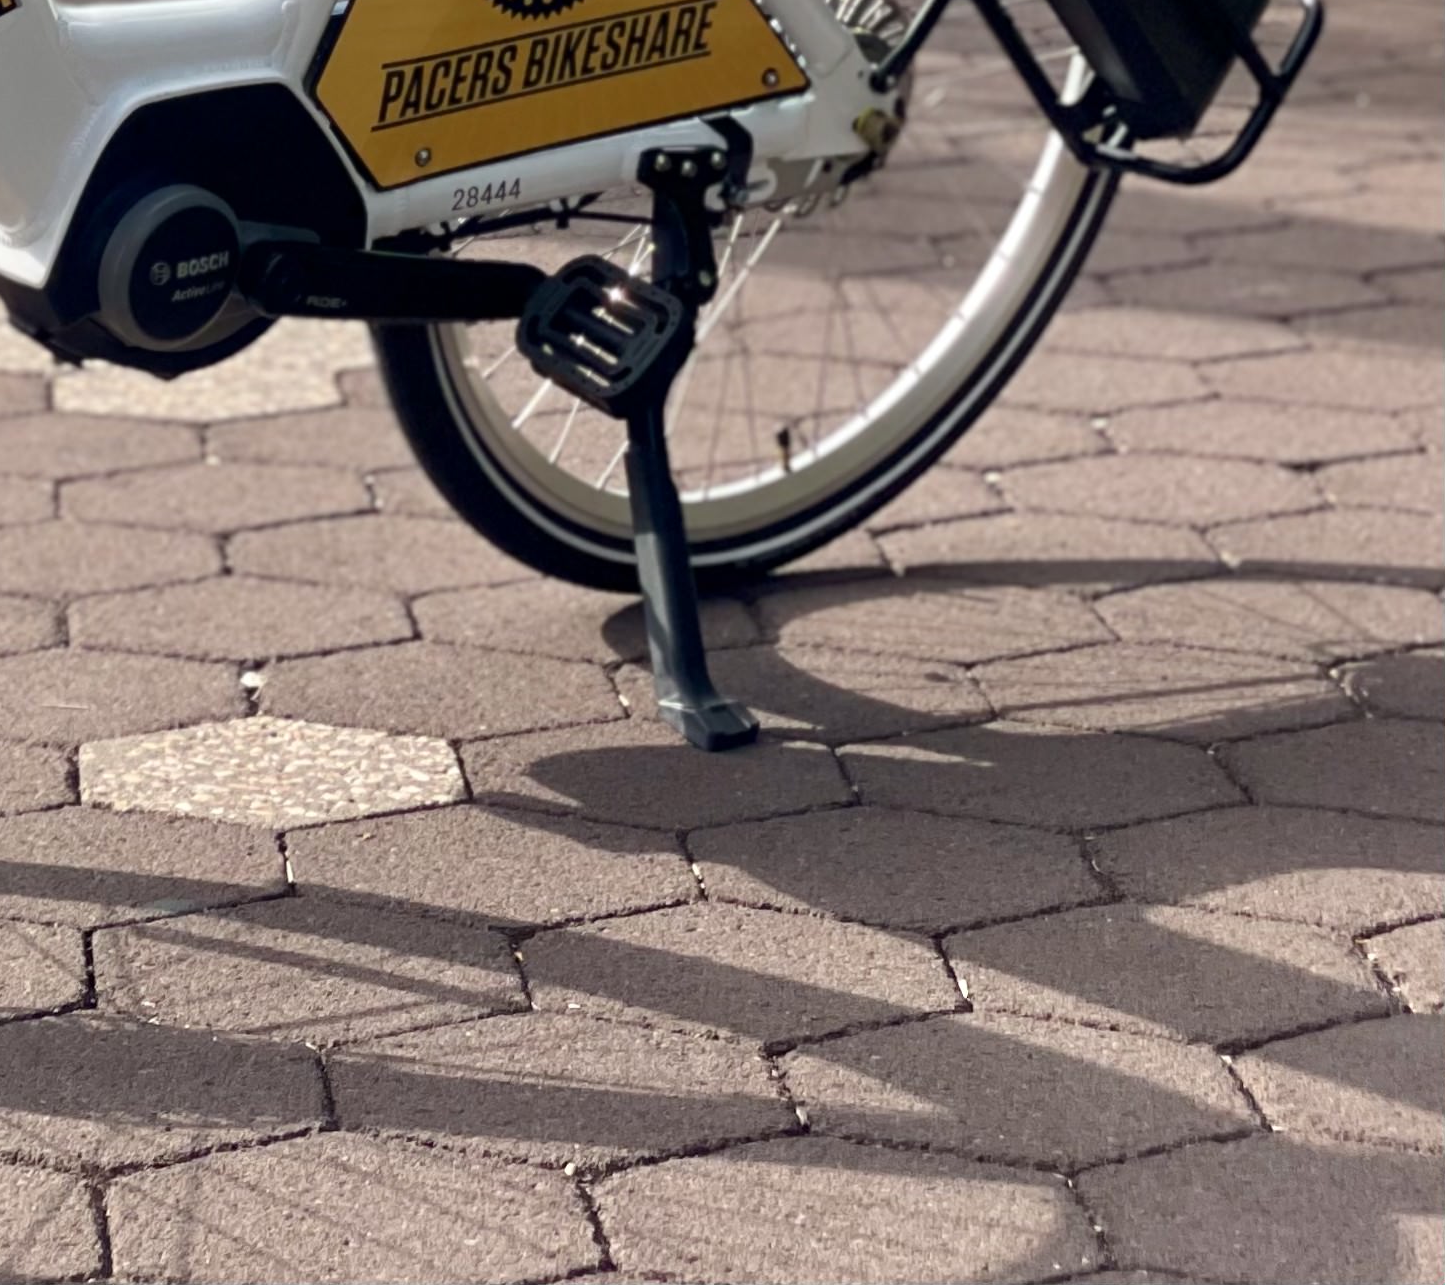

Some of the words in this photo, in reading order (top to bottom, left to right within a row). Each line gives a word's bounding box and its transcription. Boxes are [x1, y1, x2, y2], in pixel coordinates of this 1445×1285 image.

[378, 43, 517, 124] PACERS
[522, 0, 719, 90] BIKESHARE
[451, 177, 521, 211] 28444
[176, 250, 230, 279] BOSCH
